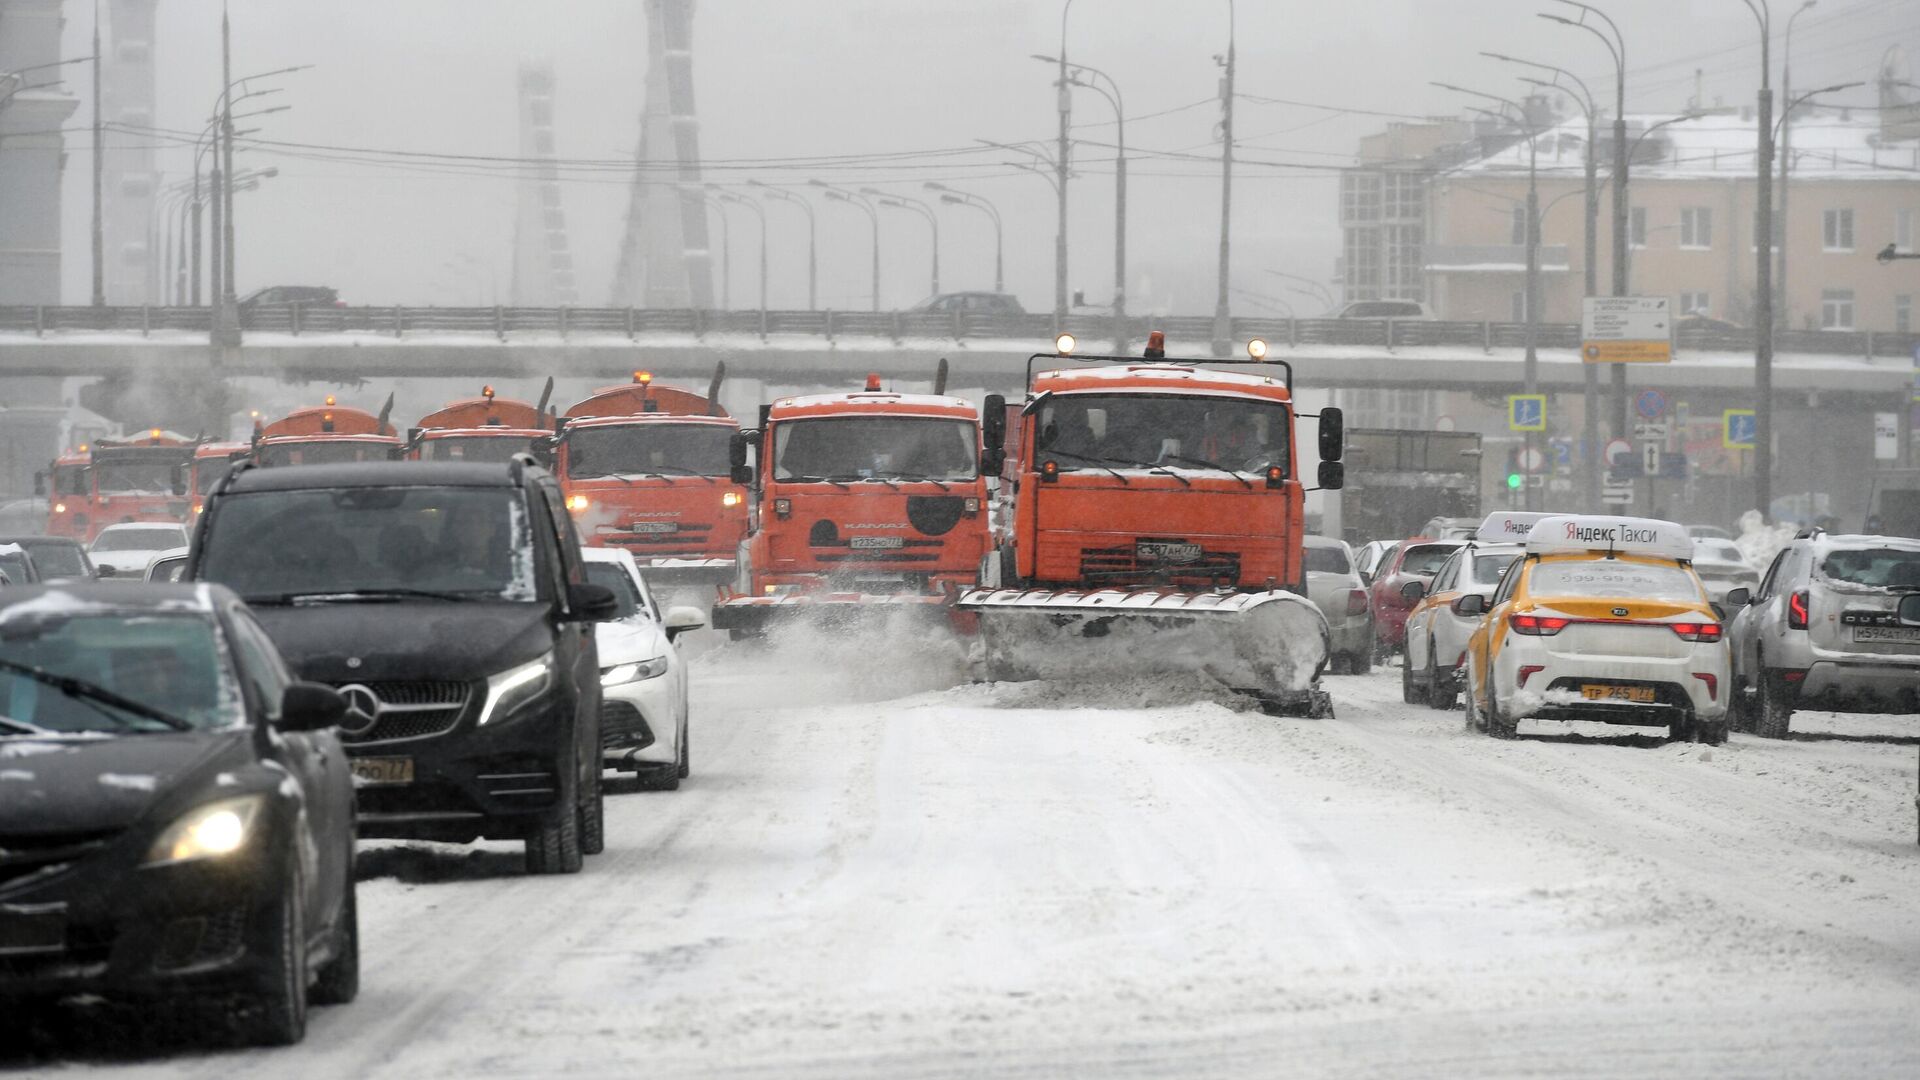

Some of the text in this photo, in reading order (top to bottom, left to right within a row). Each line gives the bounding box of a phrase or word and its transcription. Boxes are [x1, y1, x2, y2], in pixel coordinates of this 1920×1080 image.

[1504, 519, 1533, 534] Янде
[1565, 521, 1657, 543] Яндекс Такси
[1613, 608, 1627, 616] KIA
